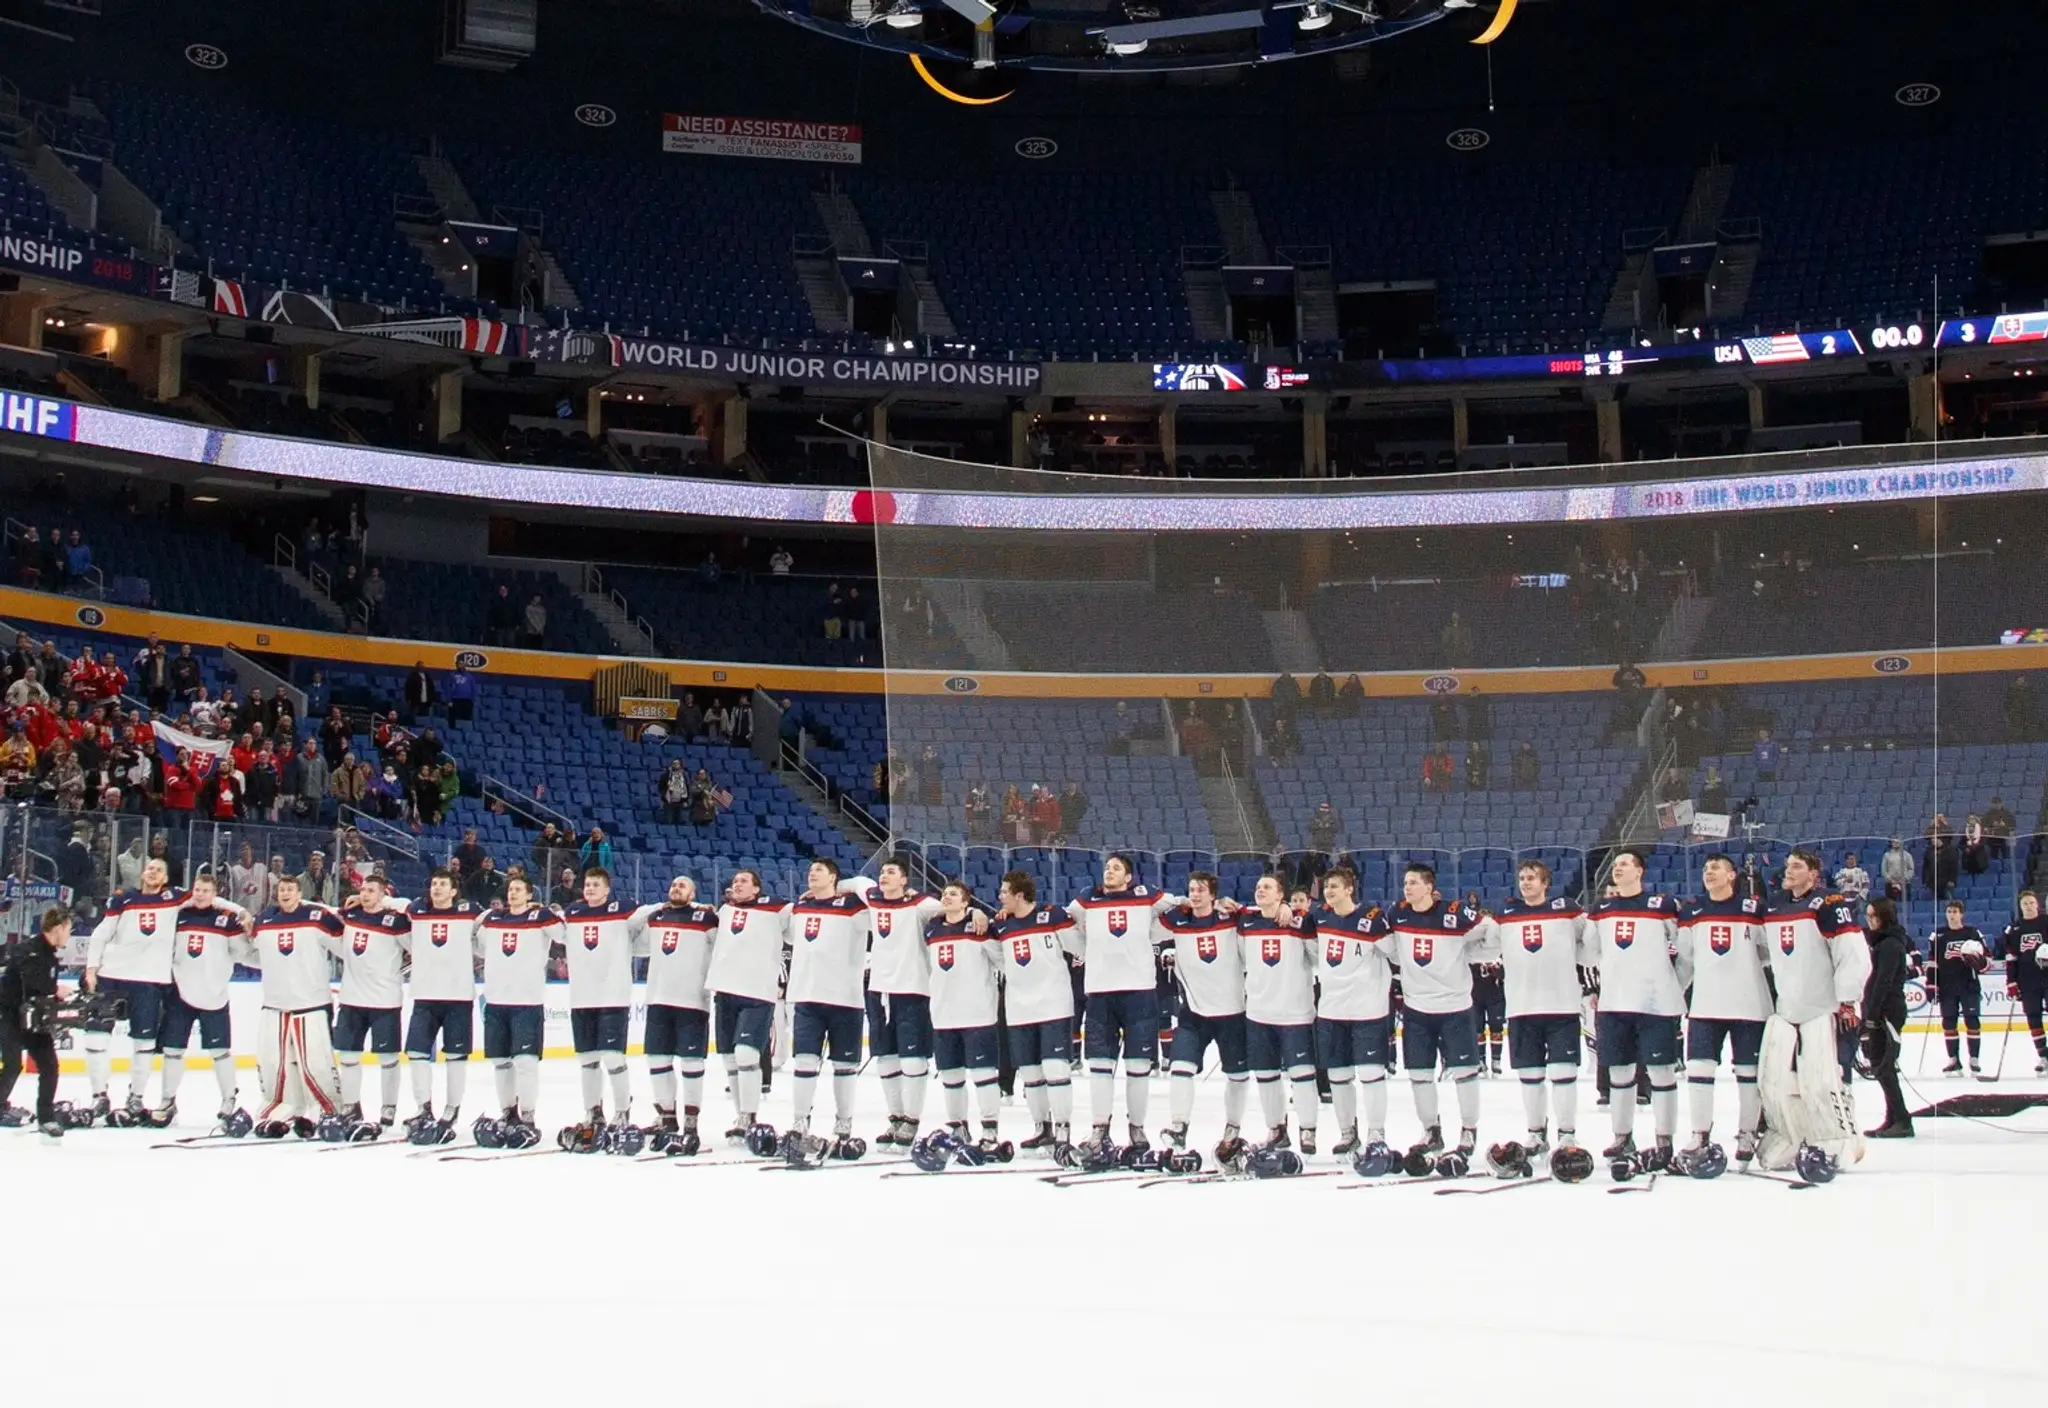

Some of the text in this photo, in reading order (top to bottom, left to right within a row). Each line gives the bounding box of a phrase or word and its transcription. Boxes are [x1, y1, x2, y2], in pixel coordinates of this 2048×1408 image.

[195, 48, 218, 65] 323
[1907, 88, 1929, 102] 327
[584, 107, 606, 122] 324
[677, 115, 849, 141] NEED ASSISTANCE?
[725, 136, 749, 146] TEXT
[750, 138, 804, 150] FANASSIST
[1457, 132, 1479, 146] 326
[717, 145, 745, 155] ISSUE
[823, 151, 855, 162] 69050
[1025, 141, 1048, 155] 325
[0, 235, 83, 272] NSHIP
[1714, 322, 1975, 363] USA 2 00.0 3
[621, 341, 1040, 387] WORLD JUNIOR CHAMPIONSHIP
[1550, 360, 1583, 373] SHOTS
[1644, 491, 1684, 508] 2018
[1735, 482, 1797, 502] WORLD
[1803, 477, 1868, 498] JUNIOR
[1875, 466, 2014, 493] CHAMPIONSHIP
[1883, 658, 1900, 671] 123
[955, 679, 968, 691] 121
[1433, 678, 1450, 690] 122
[10, 885, 57, 899] SLVAKIA
[1835, 907, 1852, 924] 30
[1743, 925, 1751, 941] A
[1044, 934, 1053, 950] C
[1354, 942, 1362, 957] A
[1829, 1090, 1845, 1131] CCM
